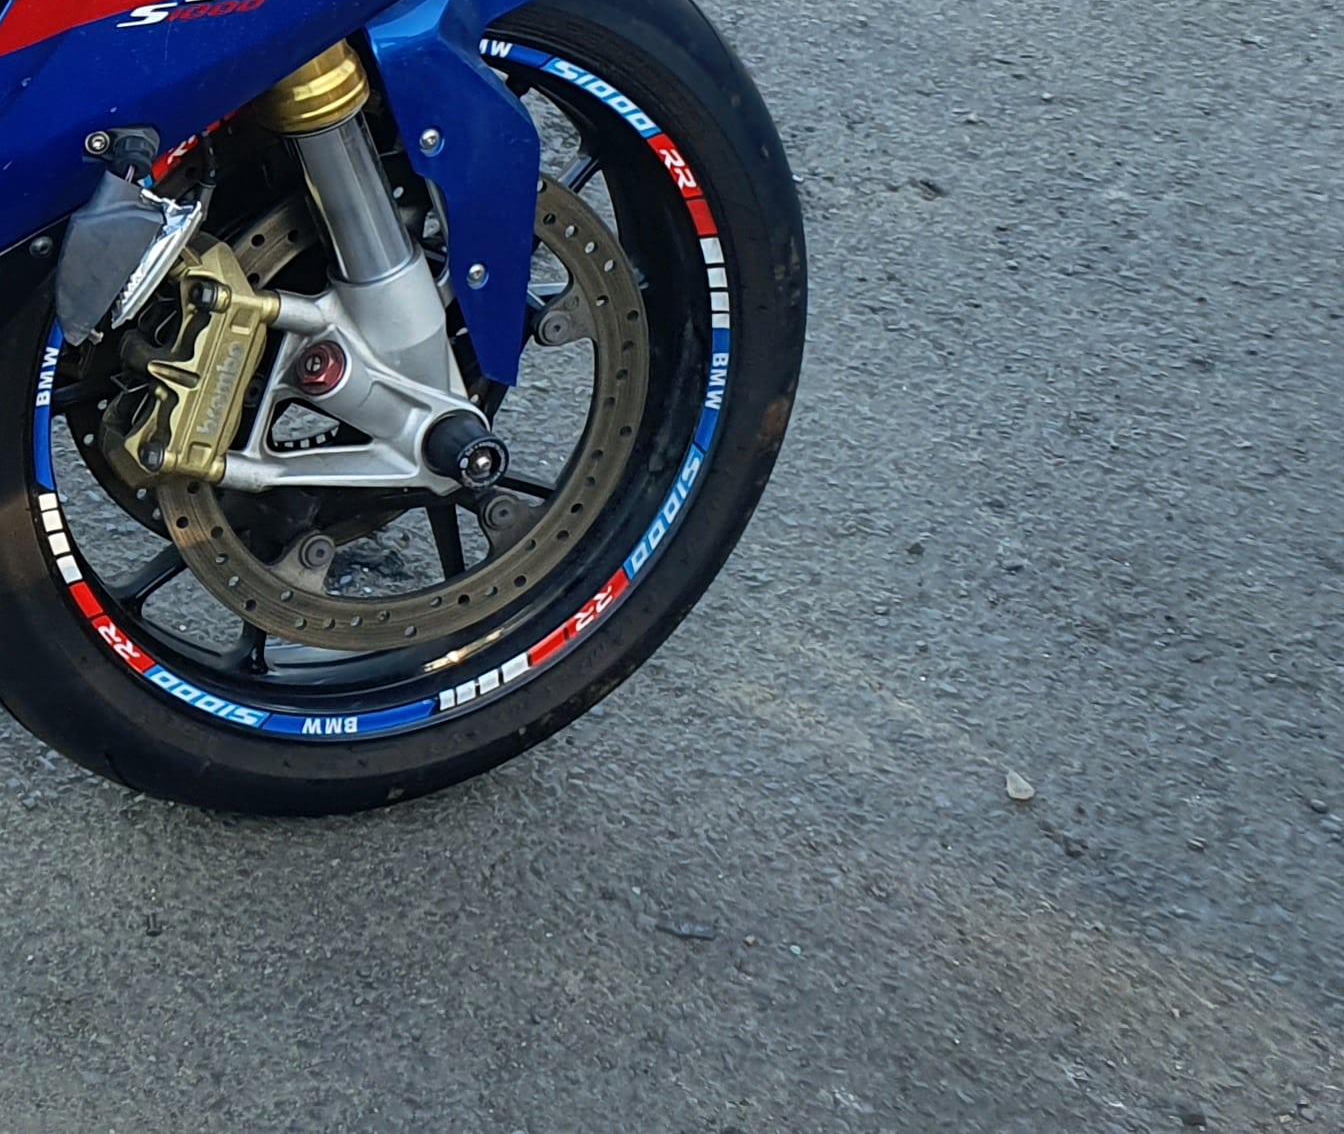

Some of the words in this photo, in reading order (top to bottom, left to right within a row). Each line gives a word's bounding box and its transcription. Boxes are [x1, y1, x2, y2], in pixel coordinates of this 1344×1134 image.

[554, 60, 656, 132] S1000
[659, 148, 698, 190] RR
[35, 346, 60, 407] BMW
[704, 352, 730, 410] BMW
[631, 456, 701, 573] S1000
[574, 585, 613, 633] RR
[97, 623, 141, 661] RR
[151, 670, 264, 726] S1000
[301, 716, 358, 735] BMW
